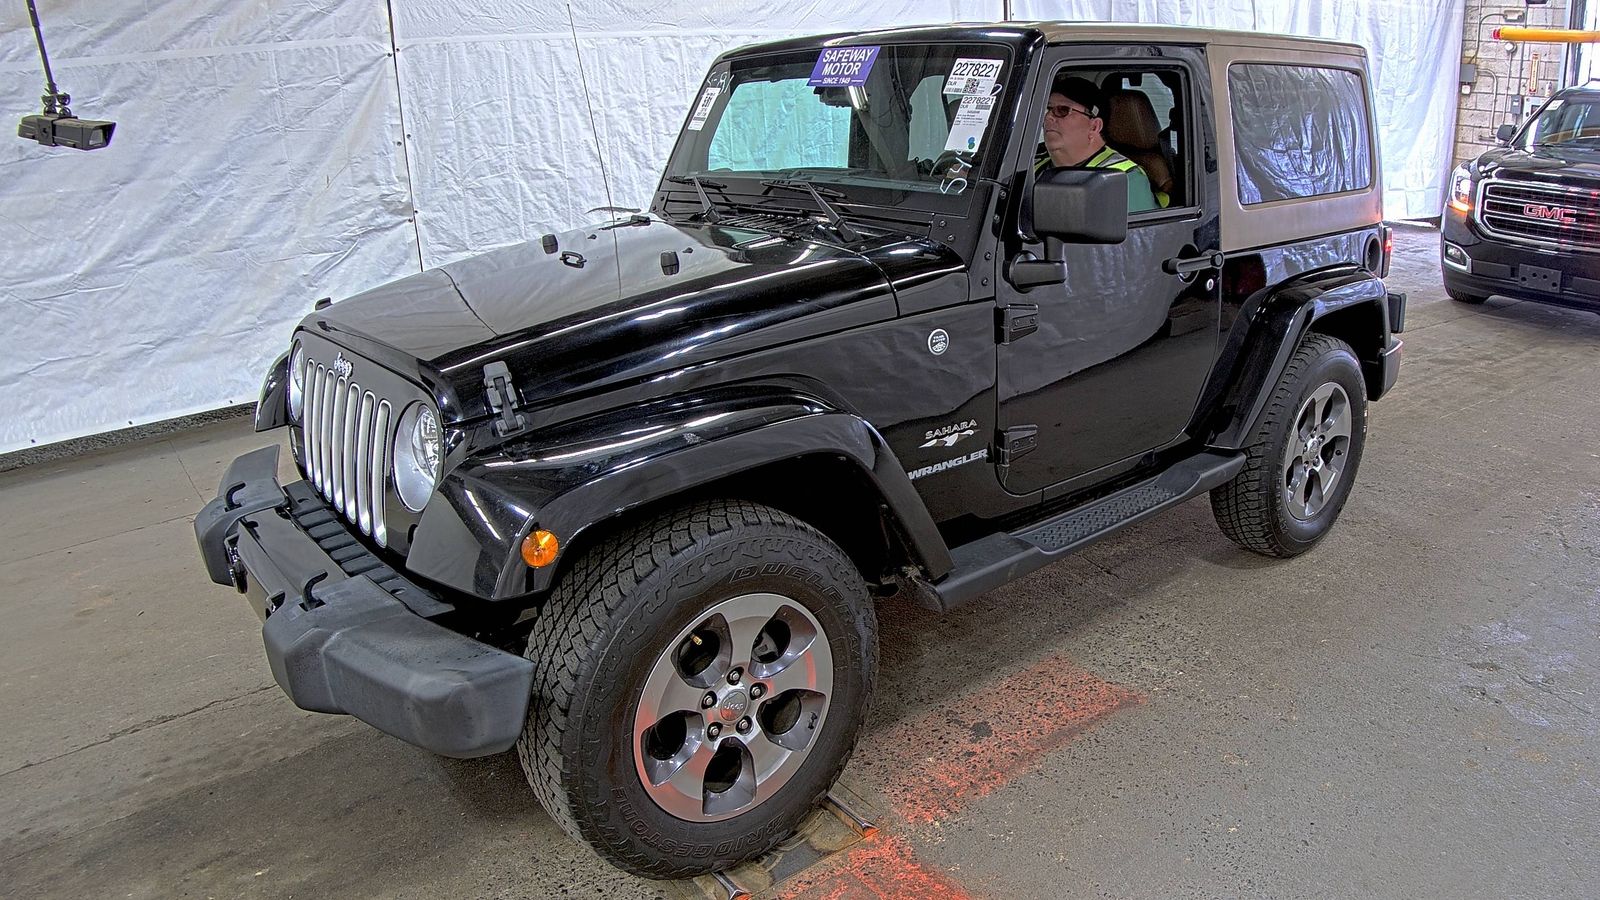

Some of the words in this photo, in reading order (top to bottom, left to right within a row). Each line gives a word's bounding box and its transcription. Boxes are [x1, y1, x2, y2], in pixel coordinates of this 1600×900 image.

[822, 48, 875, 63] SAFEWAY
[821, 62, 862, 76] MOTOR
[952, 62, 1001, 78] 2278221
[962, 97, 995, 105] 2278221
[1523, 204, 1577, 223] GMC
[925, 419, 978, 440] SAHARA
[907, 448, 989, 480] WRANGLER
